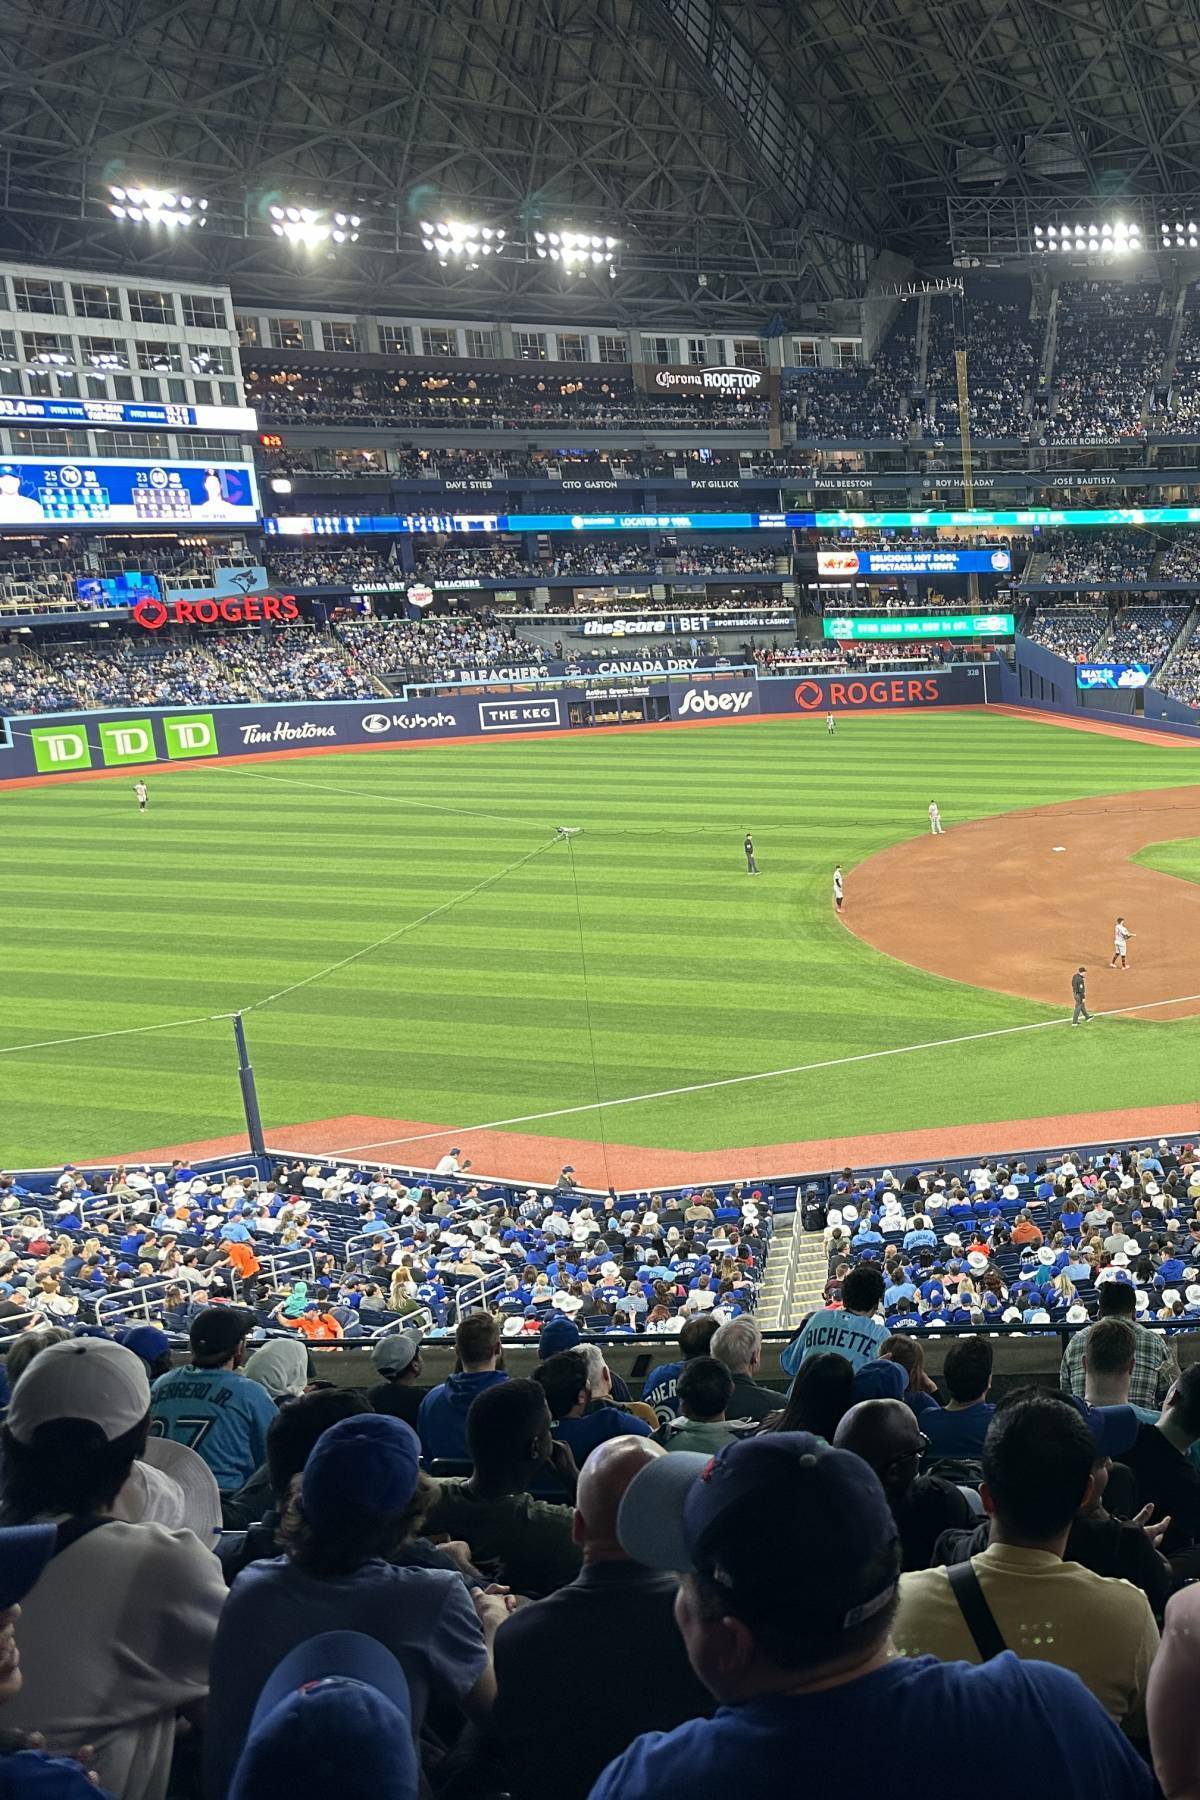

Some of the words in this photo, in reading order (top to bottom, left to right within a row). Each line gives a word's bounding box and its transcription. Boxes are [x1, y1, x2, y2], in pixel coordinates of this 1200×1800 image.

[655, 371, 702, 389] Corona
[703, 373, 761, 388] ROOFTOP
[721, 387, 746, 395] PATIO
[1050, 437, 1078, 446] JACKIE
[1079, 437, 1121, 445] ROBINSON
[445, 481, 467, 489] DAVE
[469, 481, 493, 489] STIEB
[562, 481, 582, 489] CITO
[584, 481, 618, 489] GASTON
[691, 481, 706, 489] PAT
[707, 480, 739, 489] GILLICK
[815, 480, 835, 489] PAUL
[836, 480, 873, 488] BEESTON
[935, 479, 952, 487] ROY
[954, 479, 995, 487] HALLADAY
[1052, 476, 1073, 485] JOSÉ
[1077, 477, 1116, 485] BAUTISTA
[620, 517, 656, 527] LOCATED
[869, 554, 913, 563] DELICIOUS
[914, 554, 932, 562] HOT
[870, 563, 927, 572] SPECTACULAR
[352, 583, 388, 592] CANADA
[389, 582, 405, 590] DRY
[434, 580, 480, 588] BLEACHERS
[176, 595, 299, 624] ROGERS
[584, 620, 666, 635] theScore
[680, 617, 710, 631] BET
[714, 619, 756, 627] SPORTSBOOK
[598, 660, 664, 675] CANADA
[667, 658, 698, 671] DRY
[460, 666, 549, 682] BLEACHERS
[830, 680, 939, 705] ROGERS
[678, 688, 753, 715] Sobeys
[392, 712, 456, 729] Kubota
[489, 710, 518, 721] THE
[523, 709, 551, 719] KEG
[168, 722, 211, 749] TD
[240, 724, 271, 744] Tim
[273, 721, 337, 741] Hortons
[38, 734, 85, 762] TD
[105, 728, 149, 756] TD
[805, 1327, 878, 1358] BICHETTE
